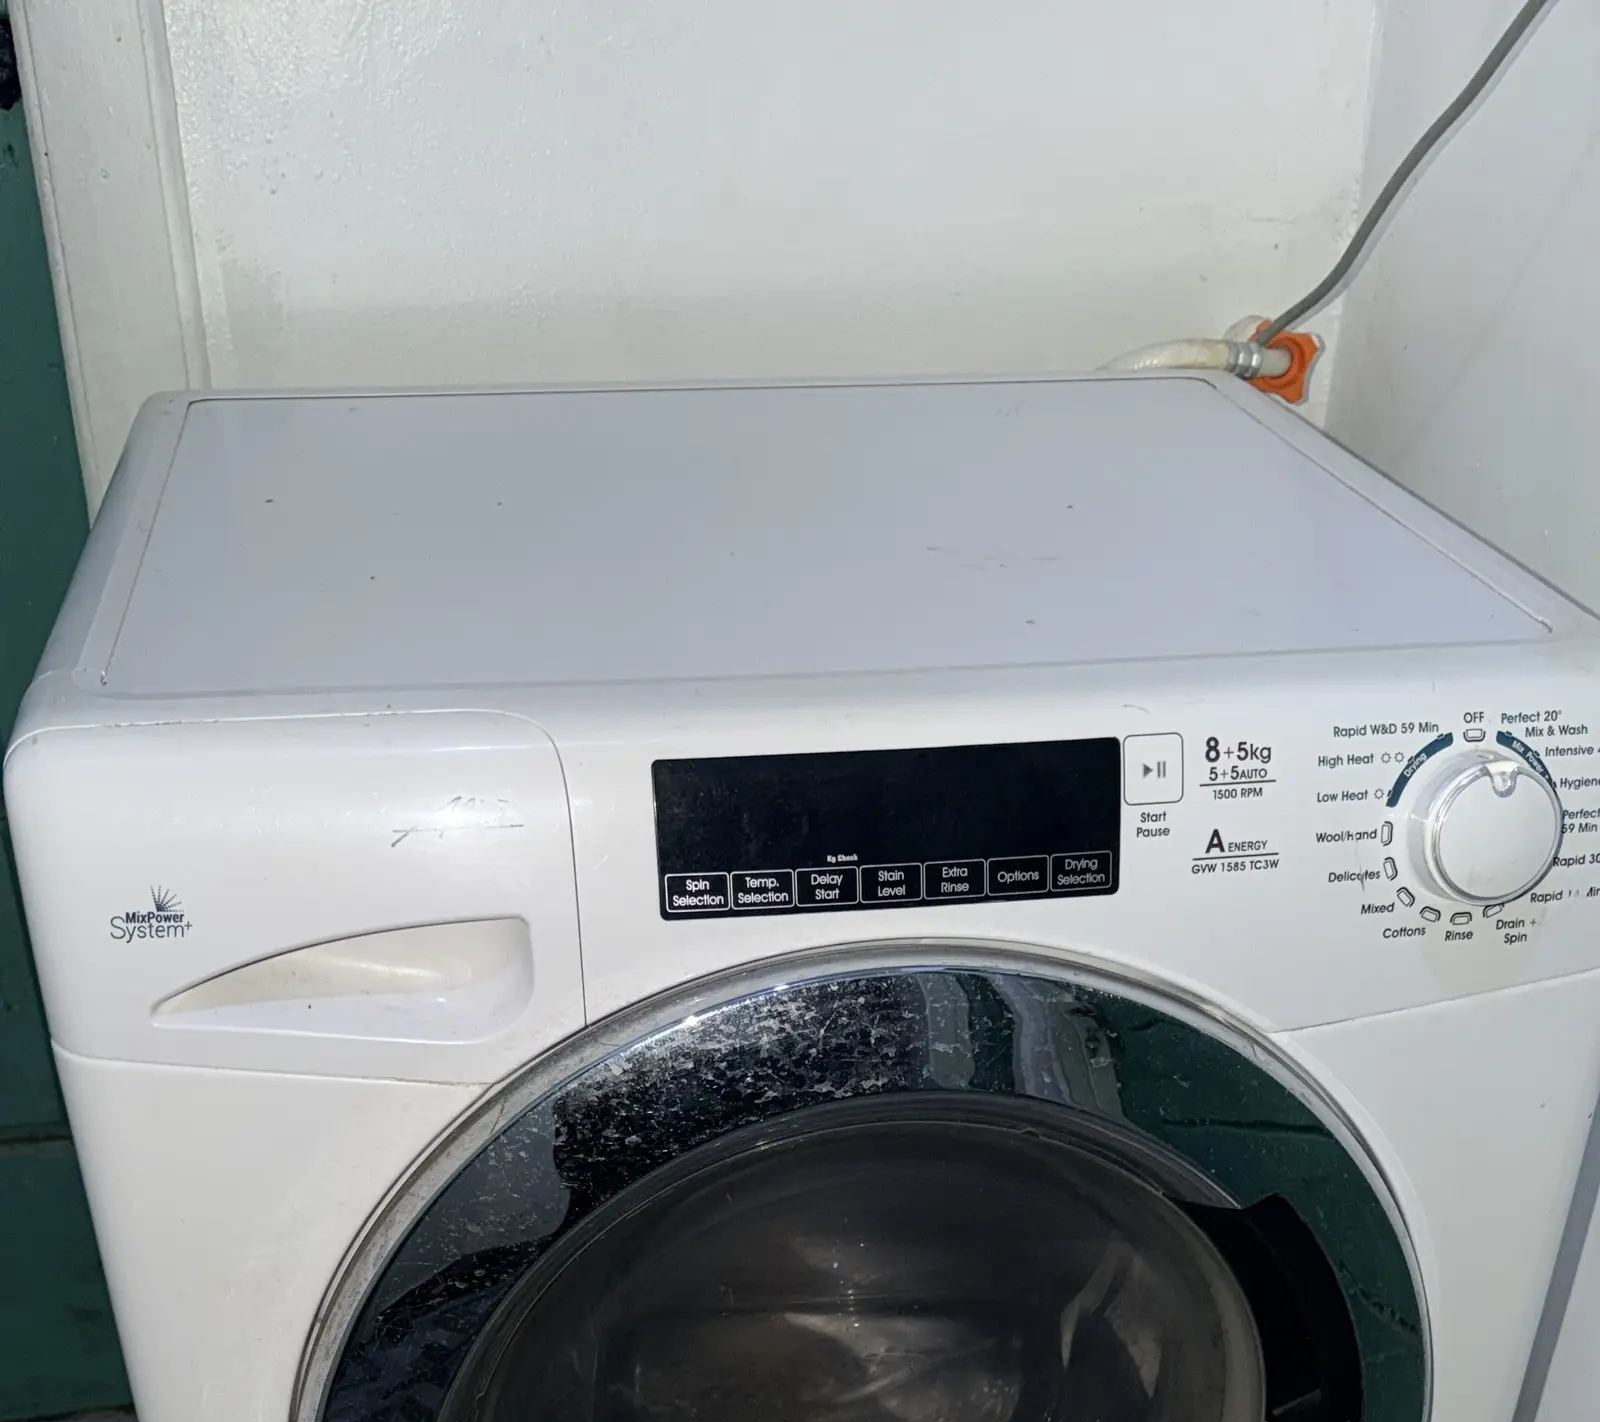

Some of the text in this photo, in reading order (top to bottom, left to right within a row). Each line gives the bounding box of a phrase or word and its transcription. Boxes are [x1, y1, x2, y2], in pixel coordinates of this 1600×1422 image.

[1463, 712, 1485, 724] OFF
[1501, 711, 1540, 724] Perfect
[1333, 722, 1439, 738] Rapid W&D 59 Min
[1525, 724, 1588, 738] Mix & Wash
[1511, 740, 1544, 774] Mix Power
[1545, 745, 1594, 757] Intensive
[1318, 753, 1375, 769] High Heat
[1403, 752, 1428, 778] Drying
[1212, 787, 1263, 800] 1500 RPM
[1317, 789, 1369, 803] Low Heat
[1140, 811, 1167, 823] Start
[1136, 827, 1171, 838] Pause
[1560, 822, 1598, 834] 59 Min
[1205, 829, 1268, 854] A ENERGY
[1064, 858, 1099, 871] Drying
[1191, 859, 1280, 875] GVW 1585 TC3W
[1553, 854, 1586, 868] Rapid
[878, 870, 905, 882] Stain
[942, 866, 968, 878] Extra
[997, 870, 1040, 884] Options
[685, 878, 710, 893] Spin
[745, 876, 780, 890] Temp.
[810, 873, 843, 886] Delay
[1057, 872, 1106, 886] Selection
[877, 884, 906, 897] Level
[940, 881, 970, 893] Rinse
[672, 894, 725, 907] Selection
[737, 891, 789, 904] Selection
[815, 888, 840, 900] Start
[1530, 890, 1563, 905] Rapid
[1360, 902, 1395, 915] Mixed
[125, 910, 185, 924] MixPower
[1496, 918, 1526, 931] Drain
[1382, 926, 1426, 939] Cottons
[1444, 930, 1474, 942] Rinse
[1503, 932, 1528, 946] Spin
